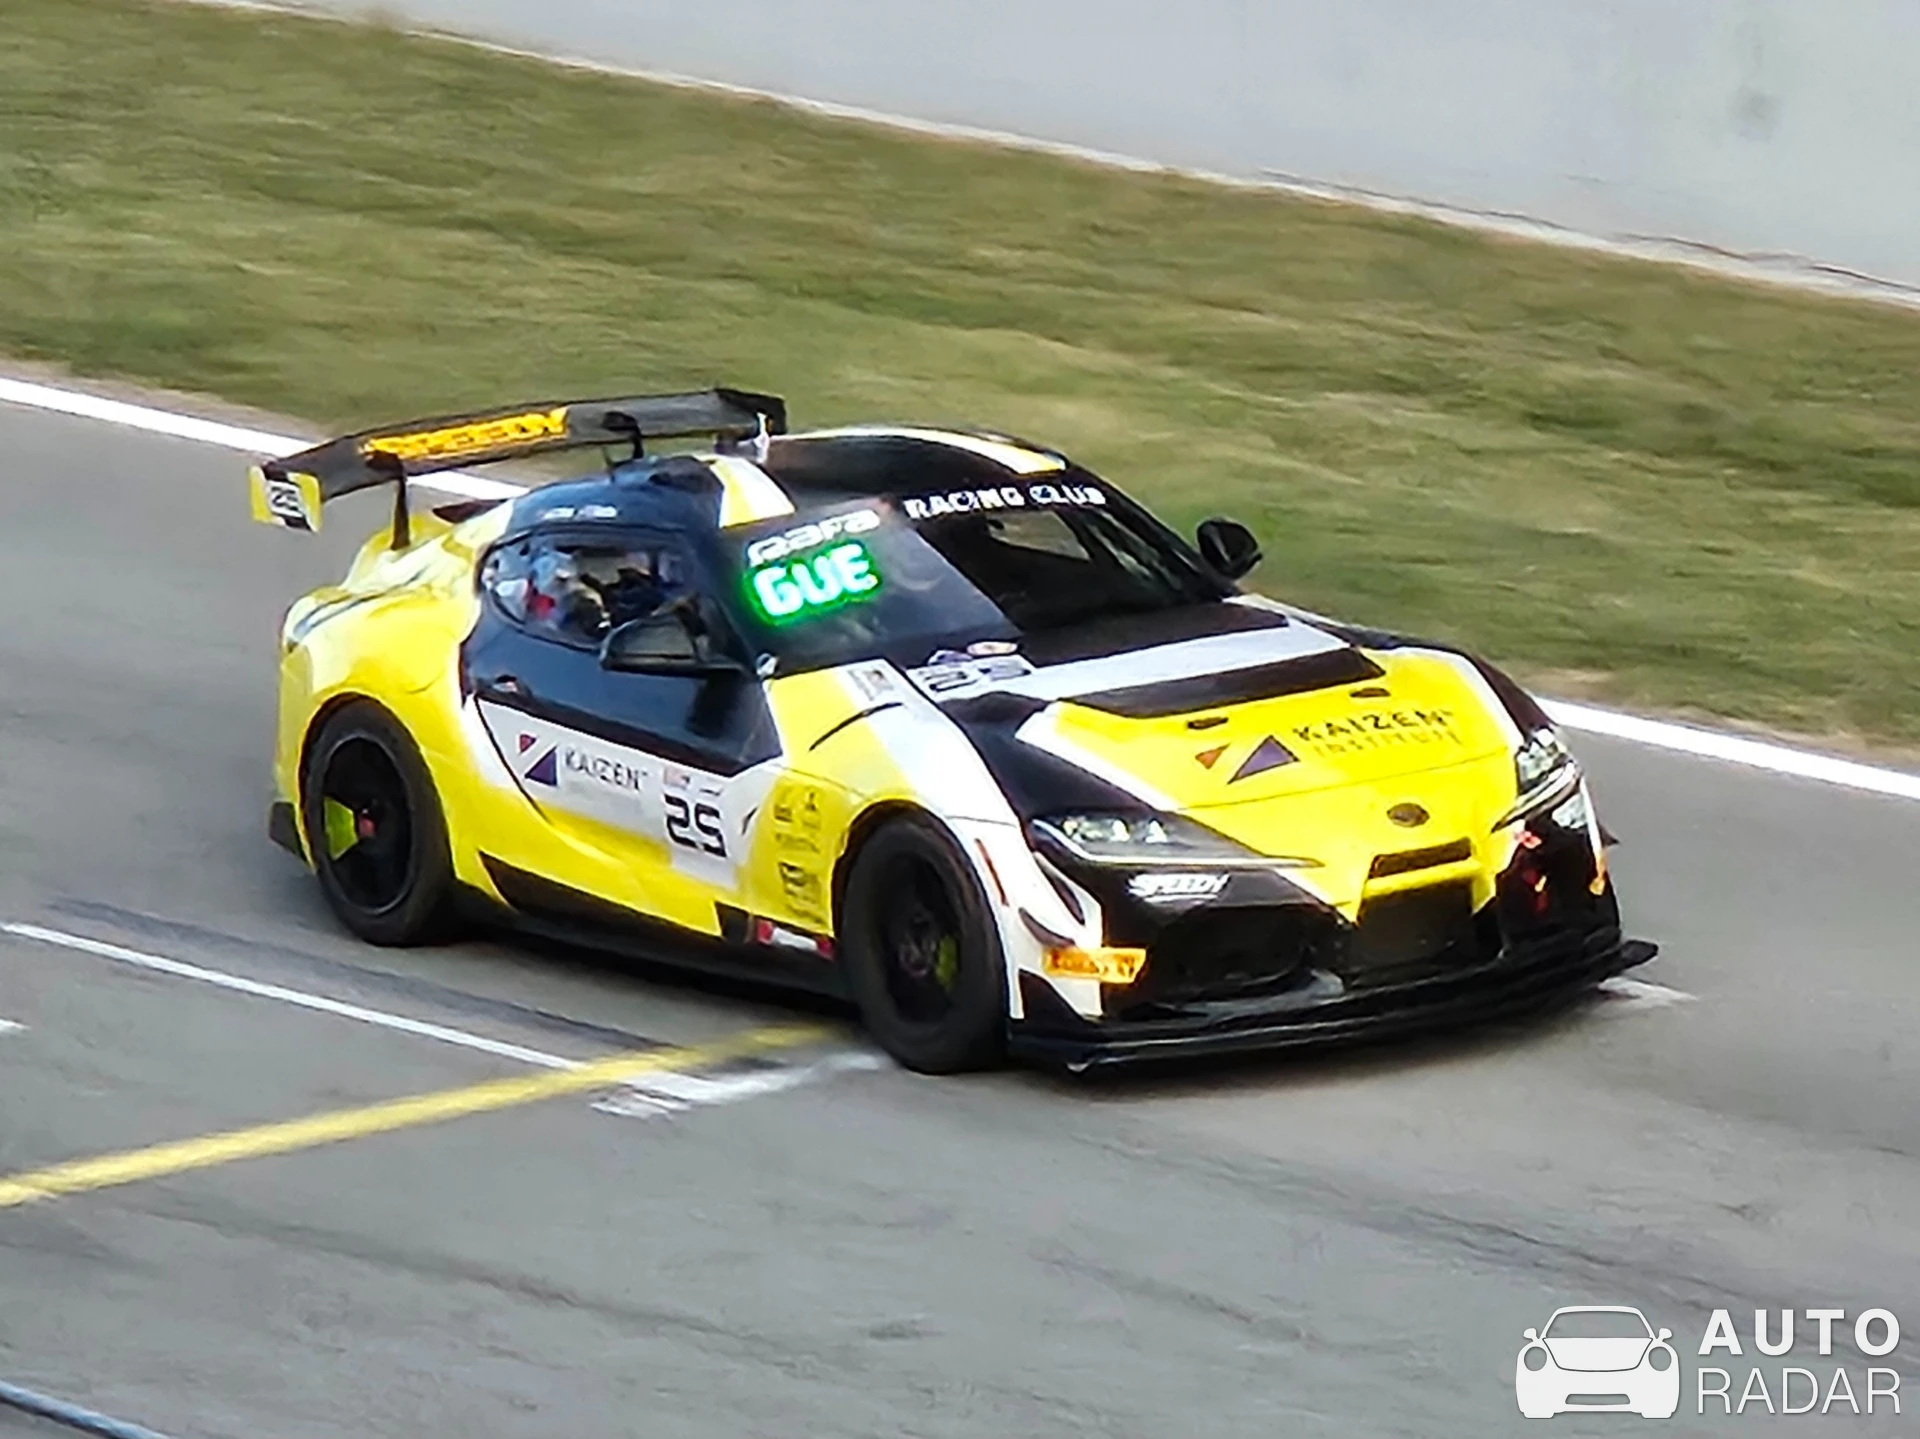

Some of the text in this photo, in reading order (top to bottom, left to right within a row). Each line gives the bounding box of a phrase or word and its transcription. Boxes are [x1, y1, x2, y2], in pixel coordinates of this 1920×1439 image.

[903, 483, 1107, 519] RACING CLUB
[752, 543, 880, 617] GUE
[663, 793, 728, 858] 25
[1127, 873, 1231, 900] SPEEDY
